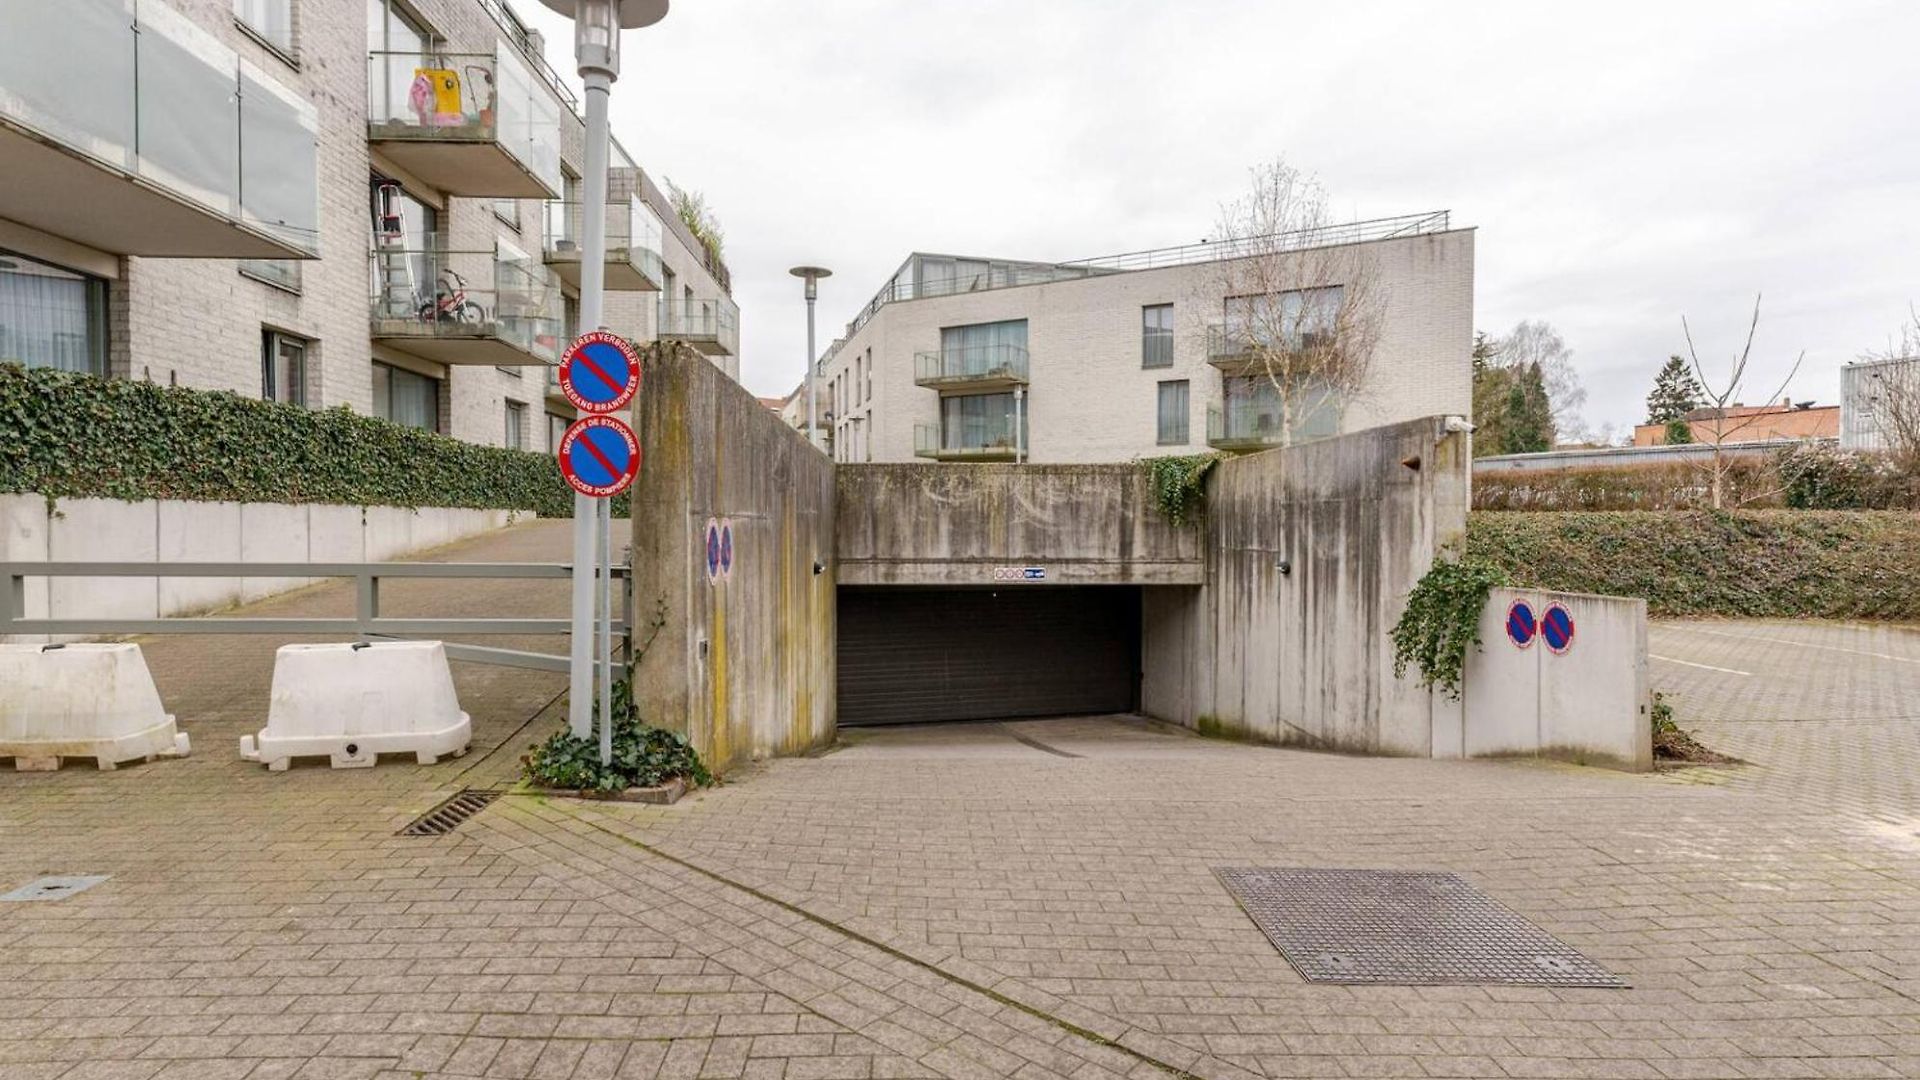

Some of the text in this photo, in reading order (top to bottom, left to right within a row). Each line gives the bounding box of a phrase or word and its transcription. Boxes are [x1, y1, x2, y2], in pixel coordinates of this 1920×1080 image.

[561, 333, 637, 367] PARKEREN VERBODEN
[562, 375, 637, 410] TOEGANG BRANDWEER
[587, 418, 599, 426] DE
[568, 474, 593, 493] ACCES
